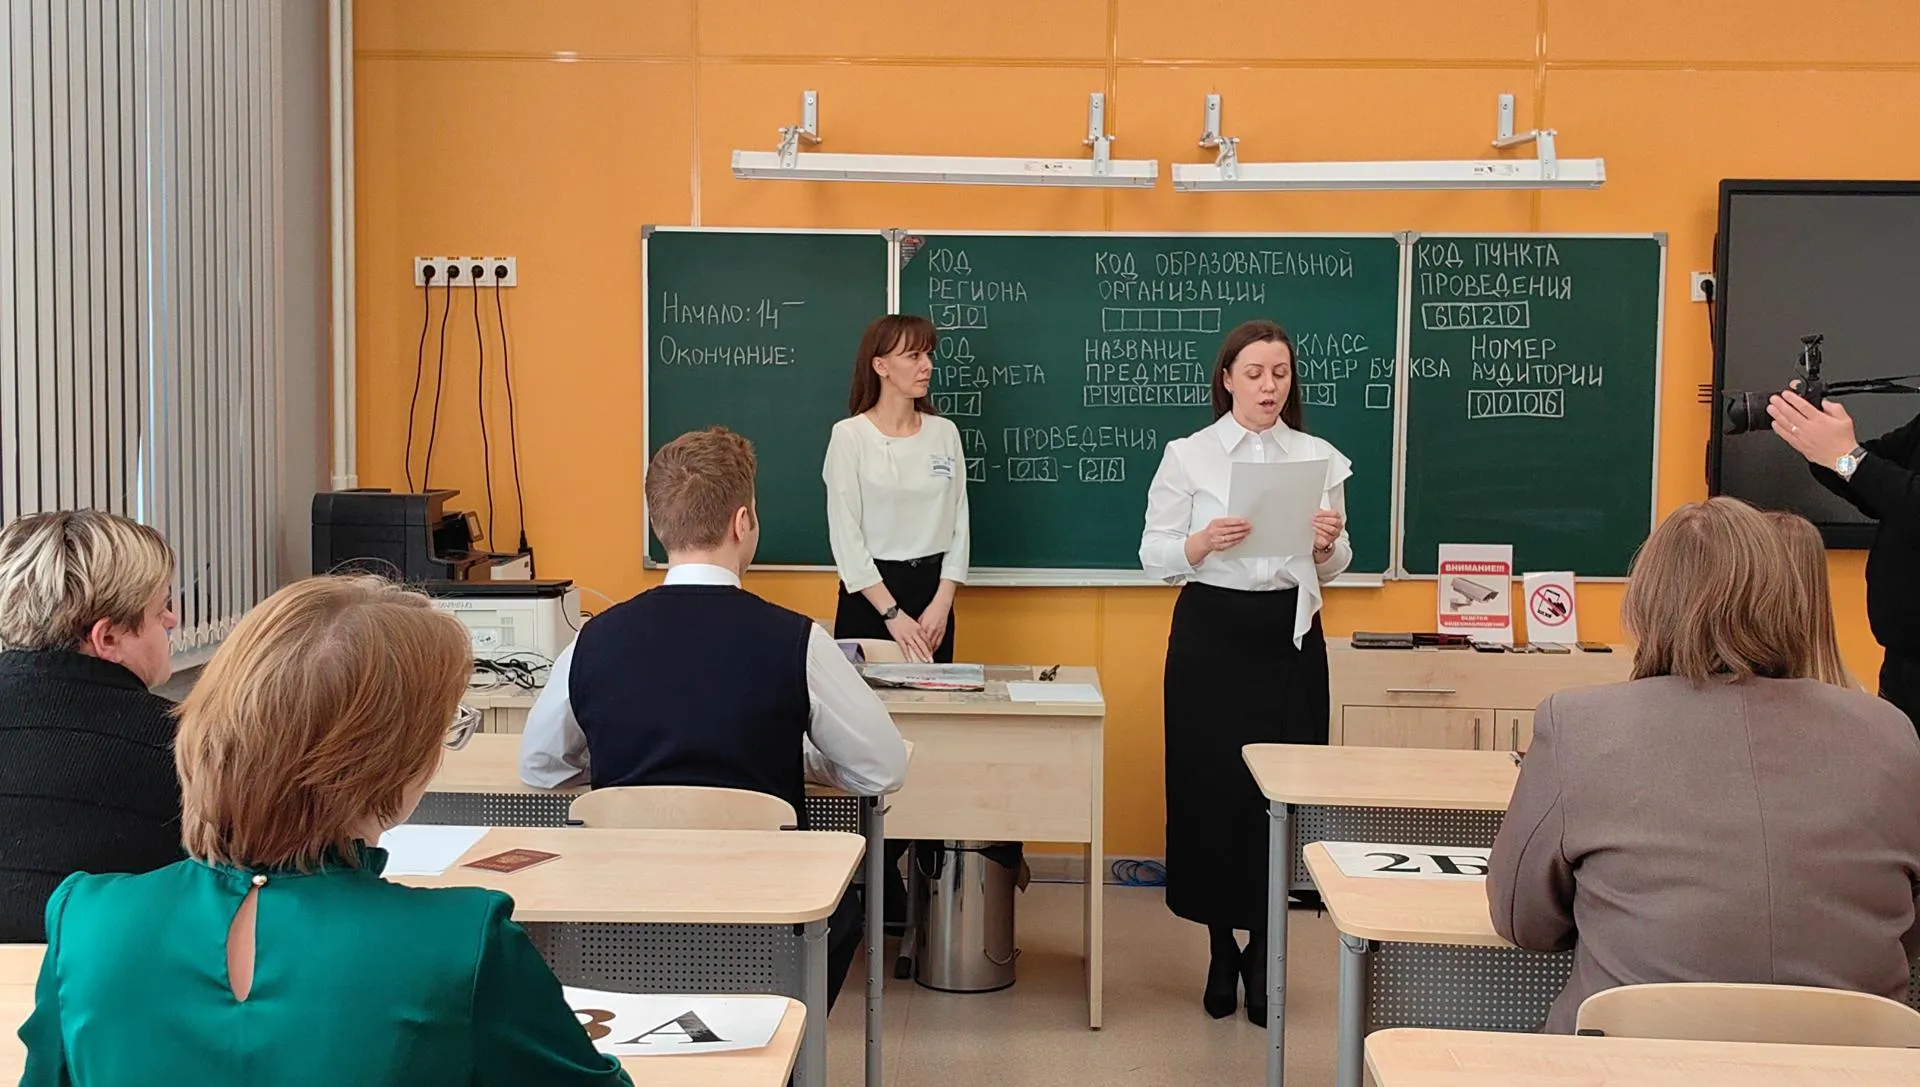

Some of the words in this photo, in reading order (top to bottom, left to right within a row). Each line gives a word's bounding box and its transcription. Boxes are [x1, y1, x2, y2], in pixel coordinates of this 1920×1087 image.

[928, 248, 972, 276] КОД
[1096, 252, 1138, 279] КОД
[1156, 249, 1353, 278] ОБРАЗОВАТЕЛЬНОЙ
[1418, 243, 1463, 268] КОД
[1475, 243, 1560, 268] ПУНКТА
[929, 277, 1028, 302] РЕГИОНА
[1099, 280, 1266, 305] ОРГАНИЗАЦИИ
[1420, 273, 1572, 300] ПРОВЕДЕНИЯ
[932, 336, 975, 364] ОД
[1085, 338, 1199, 362] НАЗВАНИЕ
[1296, 333, 1369, 357] КЛАСС
[1472, 334, 1557, 360] НОМЕР
[1086, 362, 1205, 386] ПРЕДМЕТА
[1296, 358, 1358, 380] ОМЕР
[1472, 362, 1602, 388] АУДИТОРИИ
[961, 428, 987, 453] ТА
[1003, 425, 1157, 454] ПРОВЕДЕНИЯ
